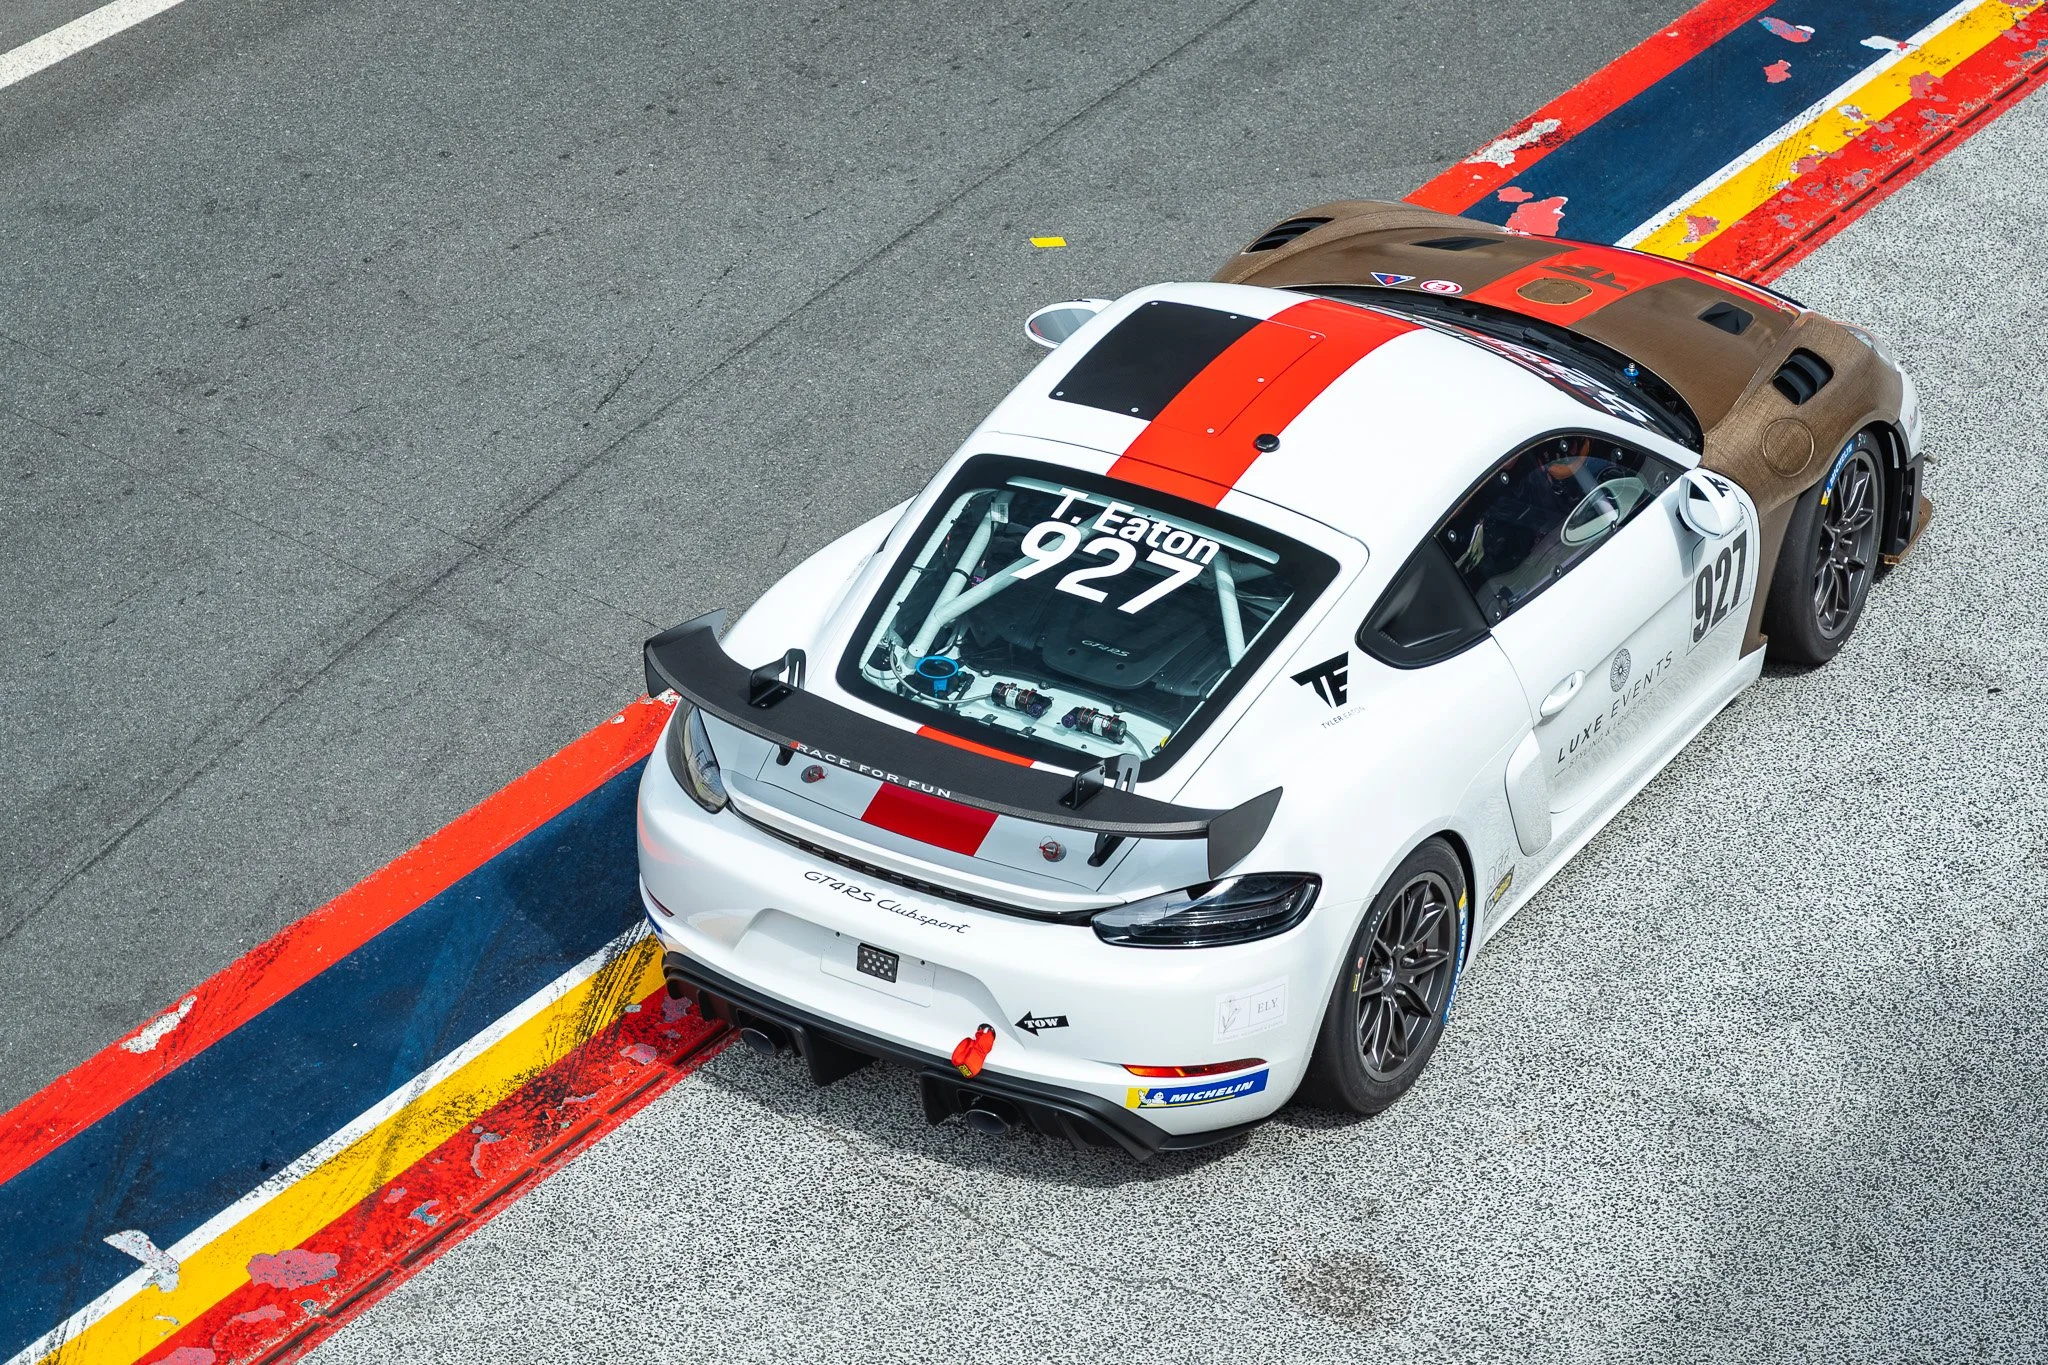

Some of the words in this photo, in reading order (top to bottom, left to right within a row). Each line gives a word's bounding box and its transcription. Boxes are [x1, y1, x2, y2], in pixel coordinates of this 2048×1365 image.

[1050, 487, 1089, 525] T.
[1091, 500, 1221, 565] Eaton
[1009, 520, 1205, 615] 927
[1692, 529, 1747, 643] 927
[1289, 650, 1349, 709] TE
[1557, 714, 1603, 764] LUXE
[1610, 650, 1673, 719] EVENTS
[1320, 714, 1344, 730] TYLER
[1342, 705, 1367, 720] EATON
[796, 743, 851, 768] RACE
[858, 764, 900, 784] FOR
[907, 779, 951, 799] FUN
[1023, 1018, 1060, 1030] TOW
[1256, 996, 1280, 1014] ELY
[1169, 1080, 1255, 1103] MICHELIN
